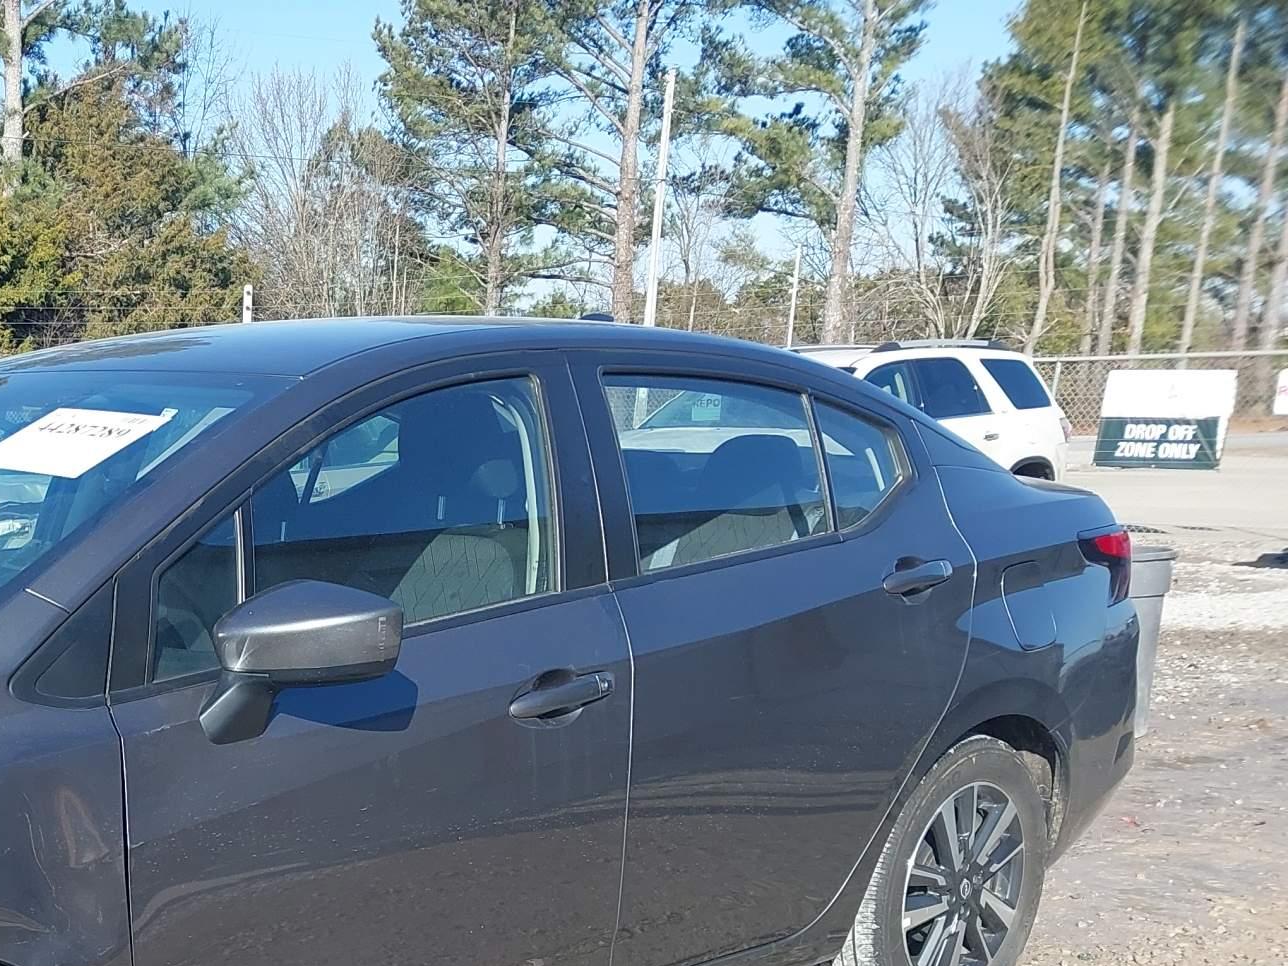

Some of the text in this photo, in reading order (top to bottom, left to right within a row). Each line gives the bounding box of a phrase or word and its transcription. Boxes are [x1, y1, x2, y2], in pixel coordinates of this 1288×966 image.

[39, 422, 132, 438] 44287289
[1123, 424, 1199, 441] DROP OFF
[1114, 441, 1201, 459] ZONE ONLY
